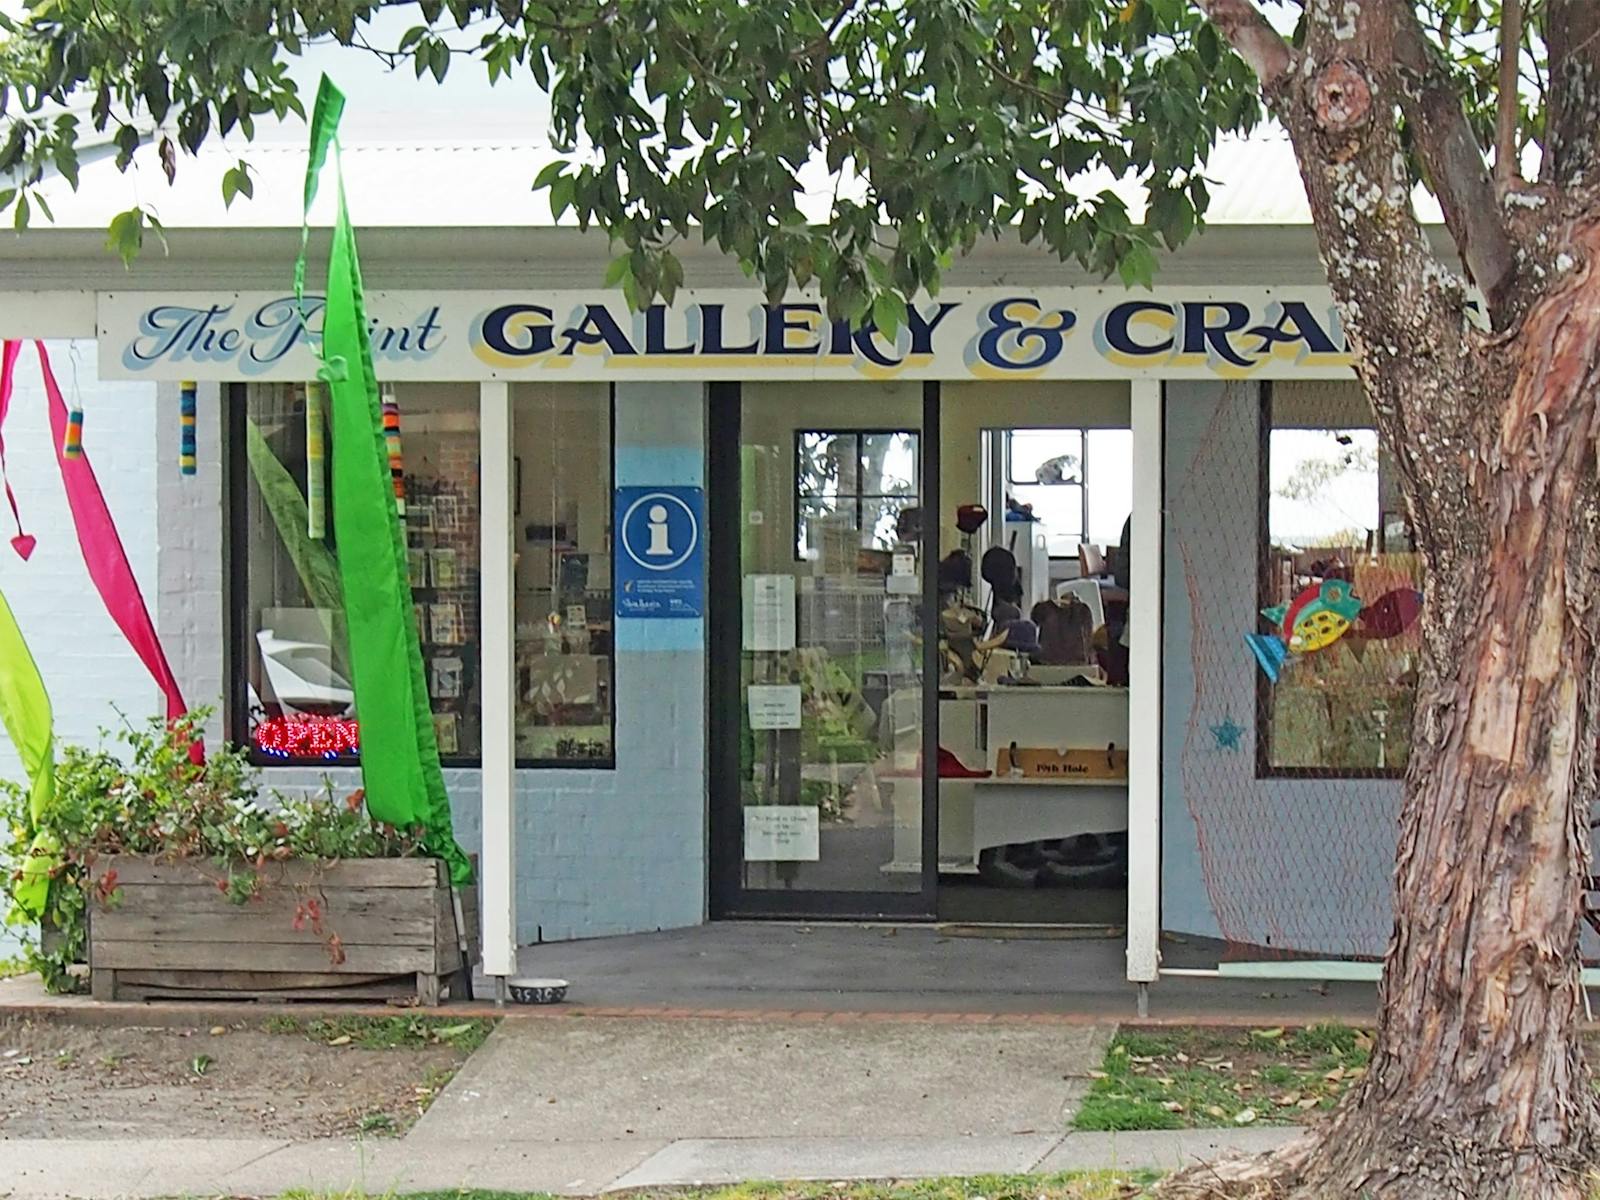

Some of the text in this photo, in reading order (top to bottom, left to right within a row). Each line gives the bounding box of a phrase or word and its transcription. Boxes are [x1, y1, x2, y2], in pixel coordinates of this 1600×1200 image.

[131, 303, 242, 361] The
[250, 296, 447, 363] Pint
[977, 296, 1078, 370] &
[1104, 300, 1353, 367] CRA
[258, 722, 358, 749] OPEN
